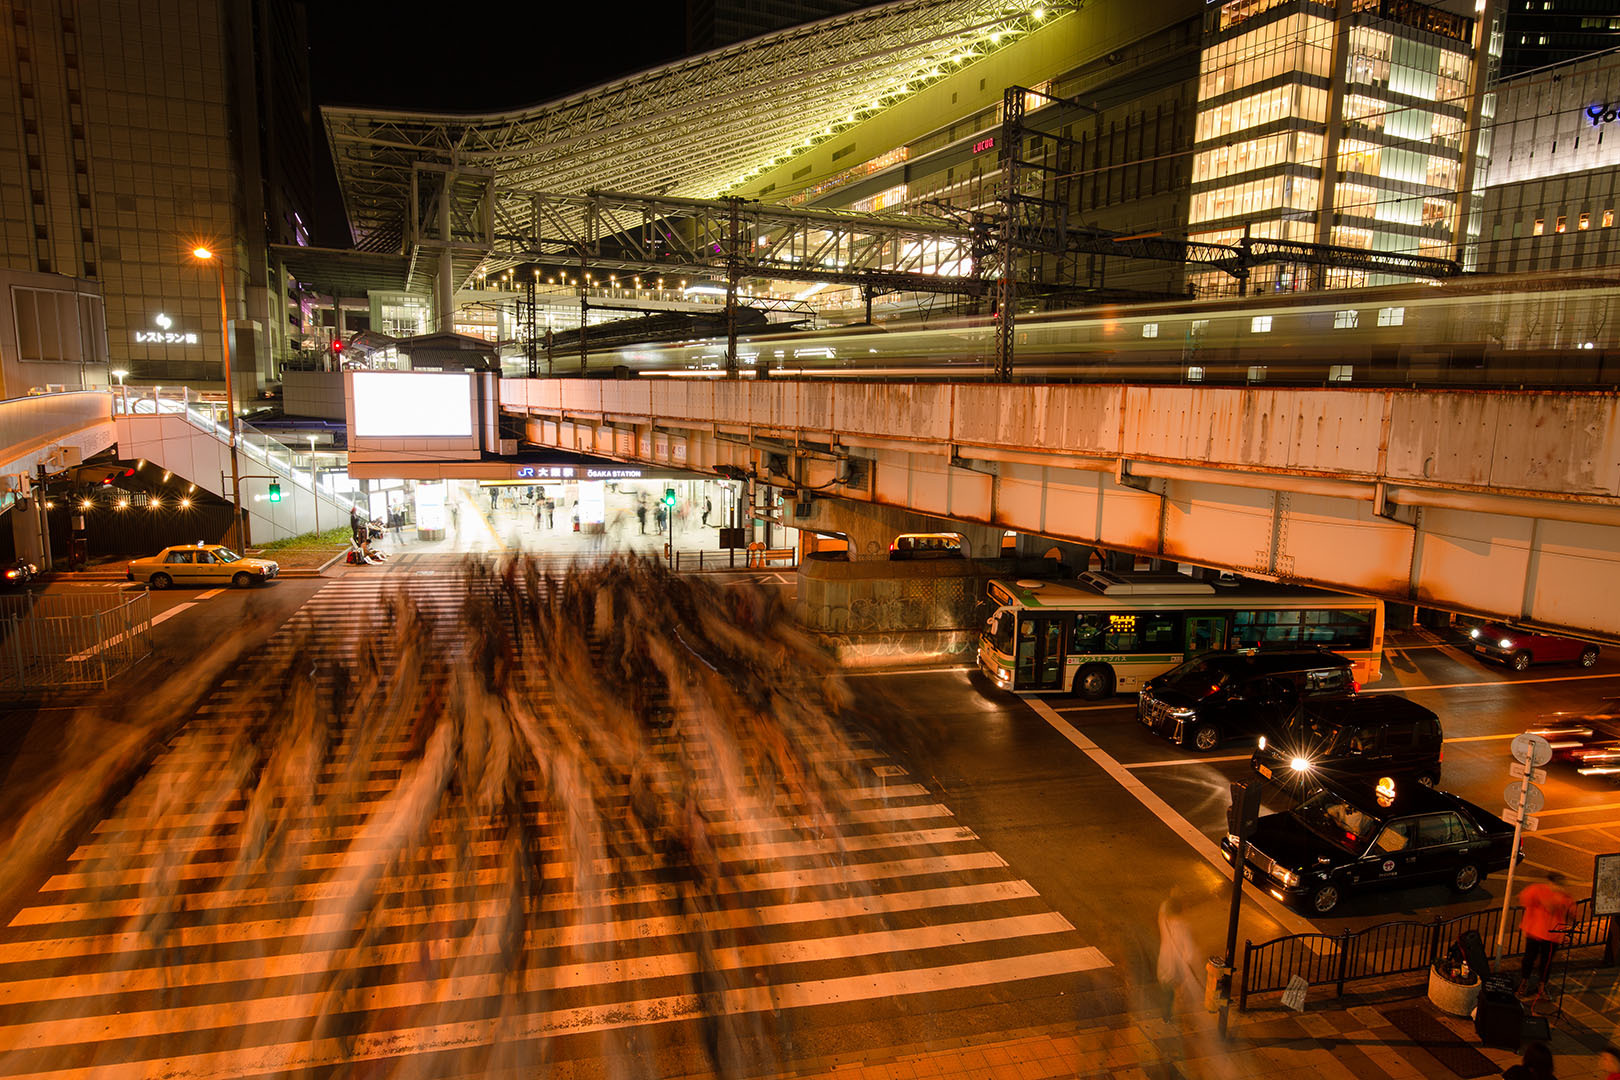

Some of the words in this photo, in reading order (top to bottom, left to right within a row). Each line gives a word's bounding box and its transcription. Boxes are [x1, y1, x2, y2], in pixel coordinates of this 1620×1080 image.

[1587, 103, 1620, 126] Yo
[136, 331, 197, 344] レストラン街
[518, 467, 534, 477] JR
[538, 467, 574, 477] 大阪駅
[612, 470, 641, 478] STATION
